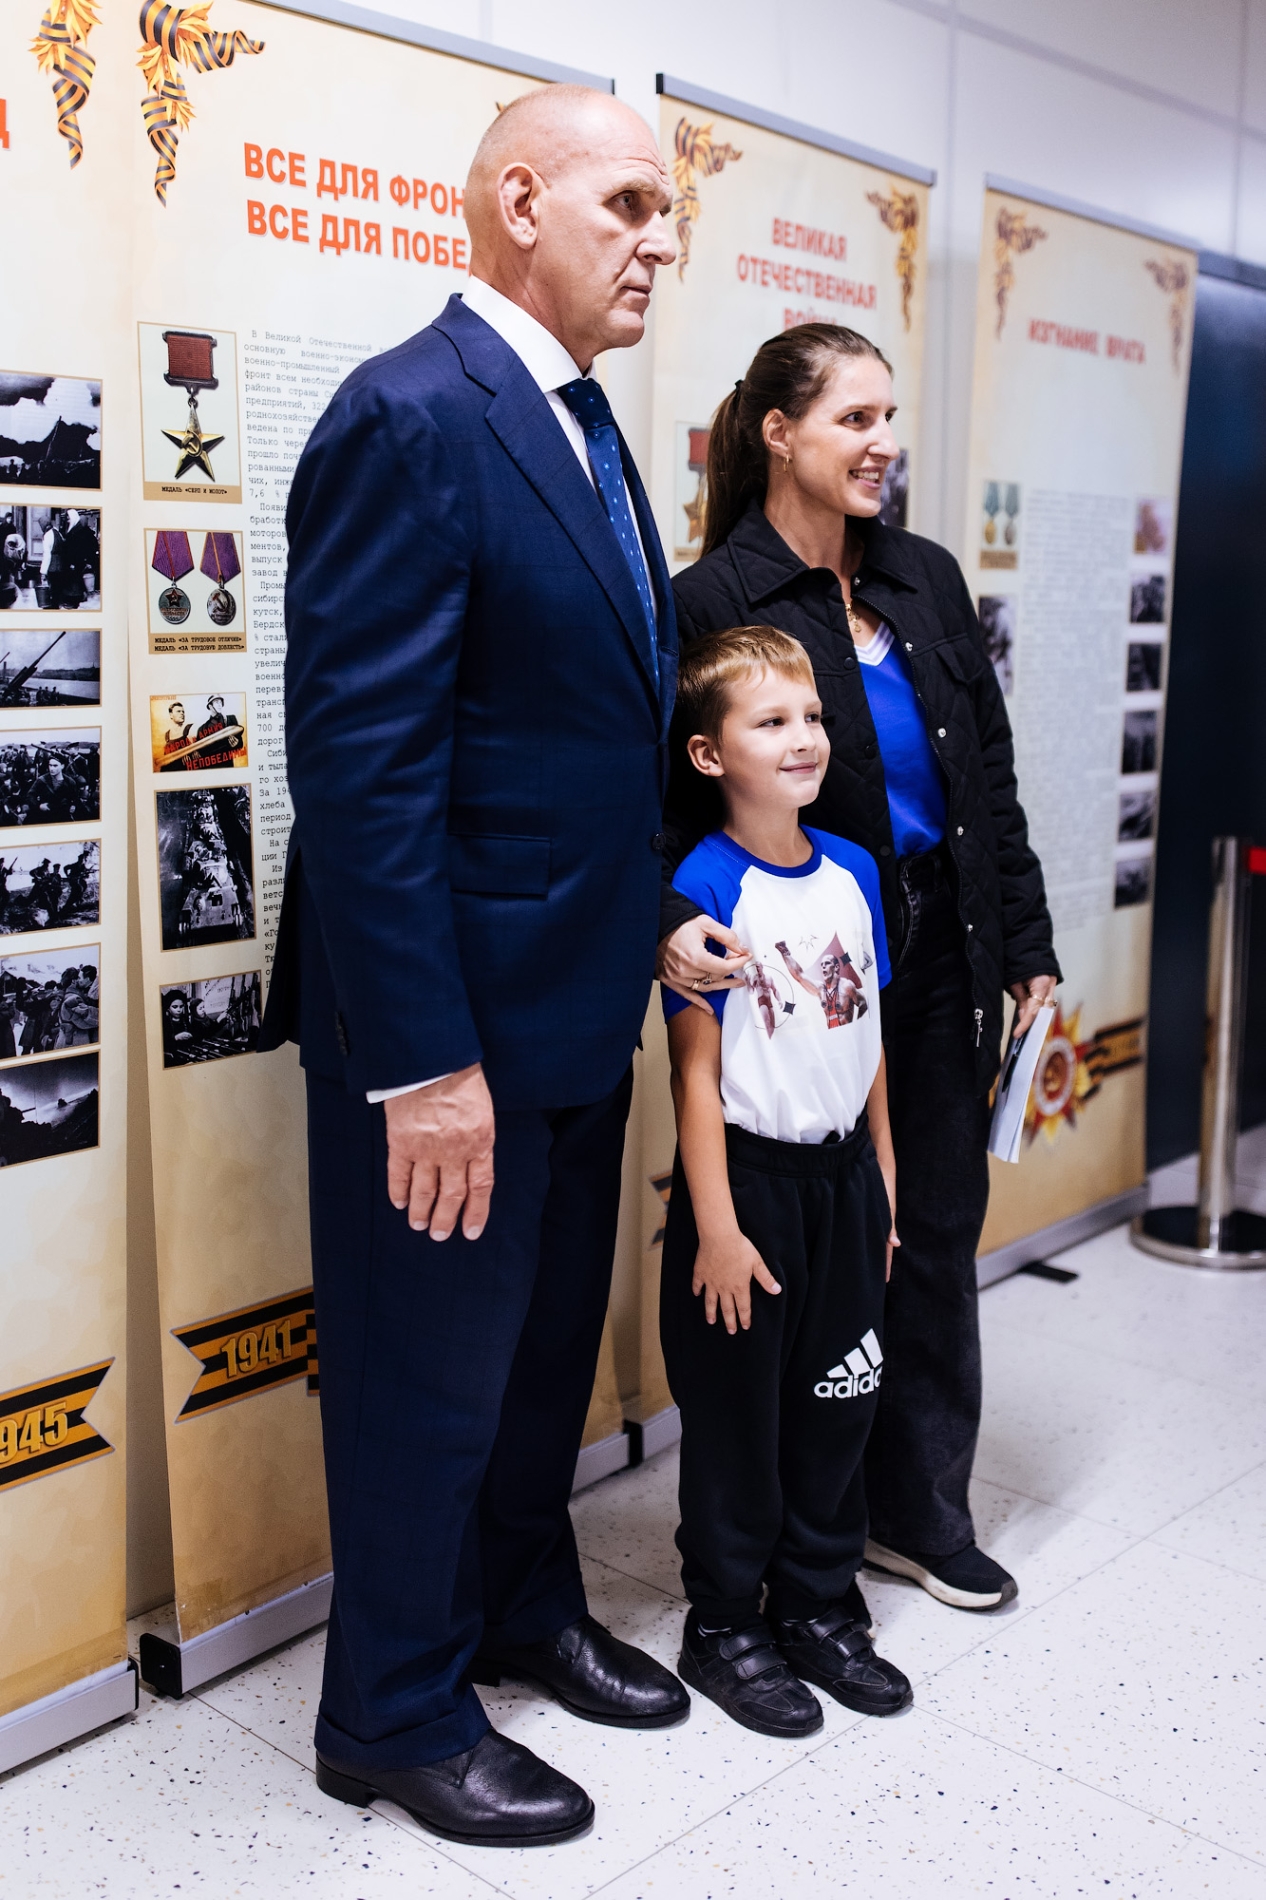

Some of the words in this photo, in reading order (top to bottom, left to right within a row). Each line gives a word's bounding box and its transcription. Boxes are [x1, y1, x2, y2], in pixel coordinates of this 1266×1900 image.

[244, 142, 307, 187] ВСЕ
[316, 158, 379, 202] ДЛЯ
[247, 199, 309, 243] ВСЕ
[319, 214, 382, 256] ДЛЯ
[392, 226, 471, 278] ПОБЕ
[772, 217, 847, 263] ВЕЛИКАЯ
[737, 253, 877, 310] ОТЕЧЕСТВЕННАЯ
[252, 330, 257, 338] В
[266, 331, 301, 343] Великой
[309, 337, 372, 352] Отечественной
[244, 344, 286, 355] основную
[245, 369, 271, 379] фронт
[276, 374, 296, 382] всем
[245, 384, 281, 392] районов
[289, 388, 319, 397] страны
[246, 397, 306, 410] предприятий,
[247, 423, 278, 433] ведена
[283, 426, 294, 434] по
[247, 435, 279, 445] Только
[247, 450, 279, 459] прошло
[248, 477, 268, 486] чих,
[249, 488, 265, 498] 7,6
[250, 543, 286, 552] ментов,
[251, 556, 283, 564] выпуск
[252, 569, 278, 577] завод
[253, 609, 283, 617] кутск,
[254, 647, 286, 656] страны
[199, 722, 224, 739] АРМИЯ
[257, 723, 273, 732] 700
[257, 738, 284, 746] дорог
[185, 746, 247, 771] НЕПОБЕДИМЫ
[259, 789, 270, 797] За
[260, 801, 286, 810] хлеба
[260, 813, 292, 823] период
[269, 839, 280, 847] На
[271, 865, 283, 873] Из
[221, 1320, 292, 1378] 1941
